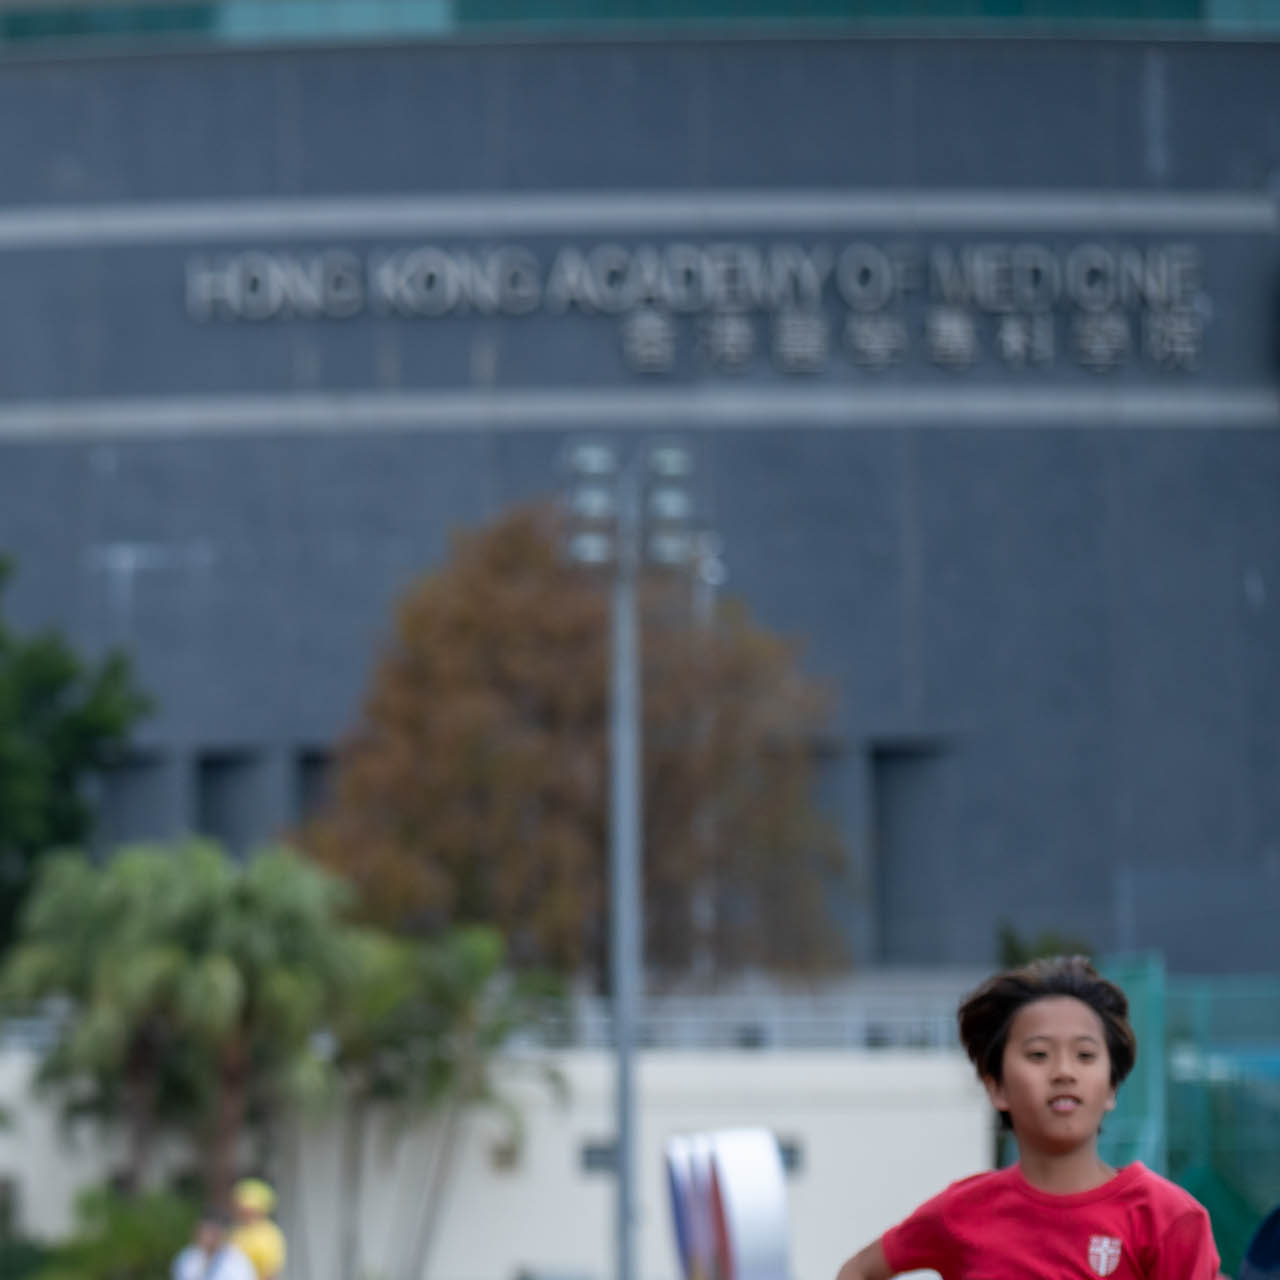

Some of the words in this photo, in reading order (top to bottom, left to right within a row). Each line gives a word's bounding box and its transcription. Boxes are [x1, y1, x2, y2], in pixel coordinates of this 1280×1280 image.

[186, 252, 364, 320] HONG
[371, 248, 542, 316] KONG
[548, 246, 833, 314] ACADEMY
